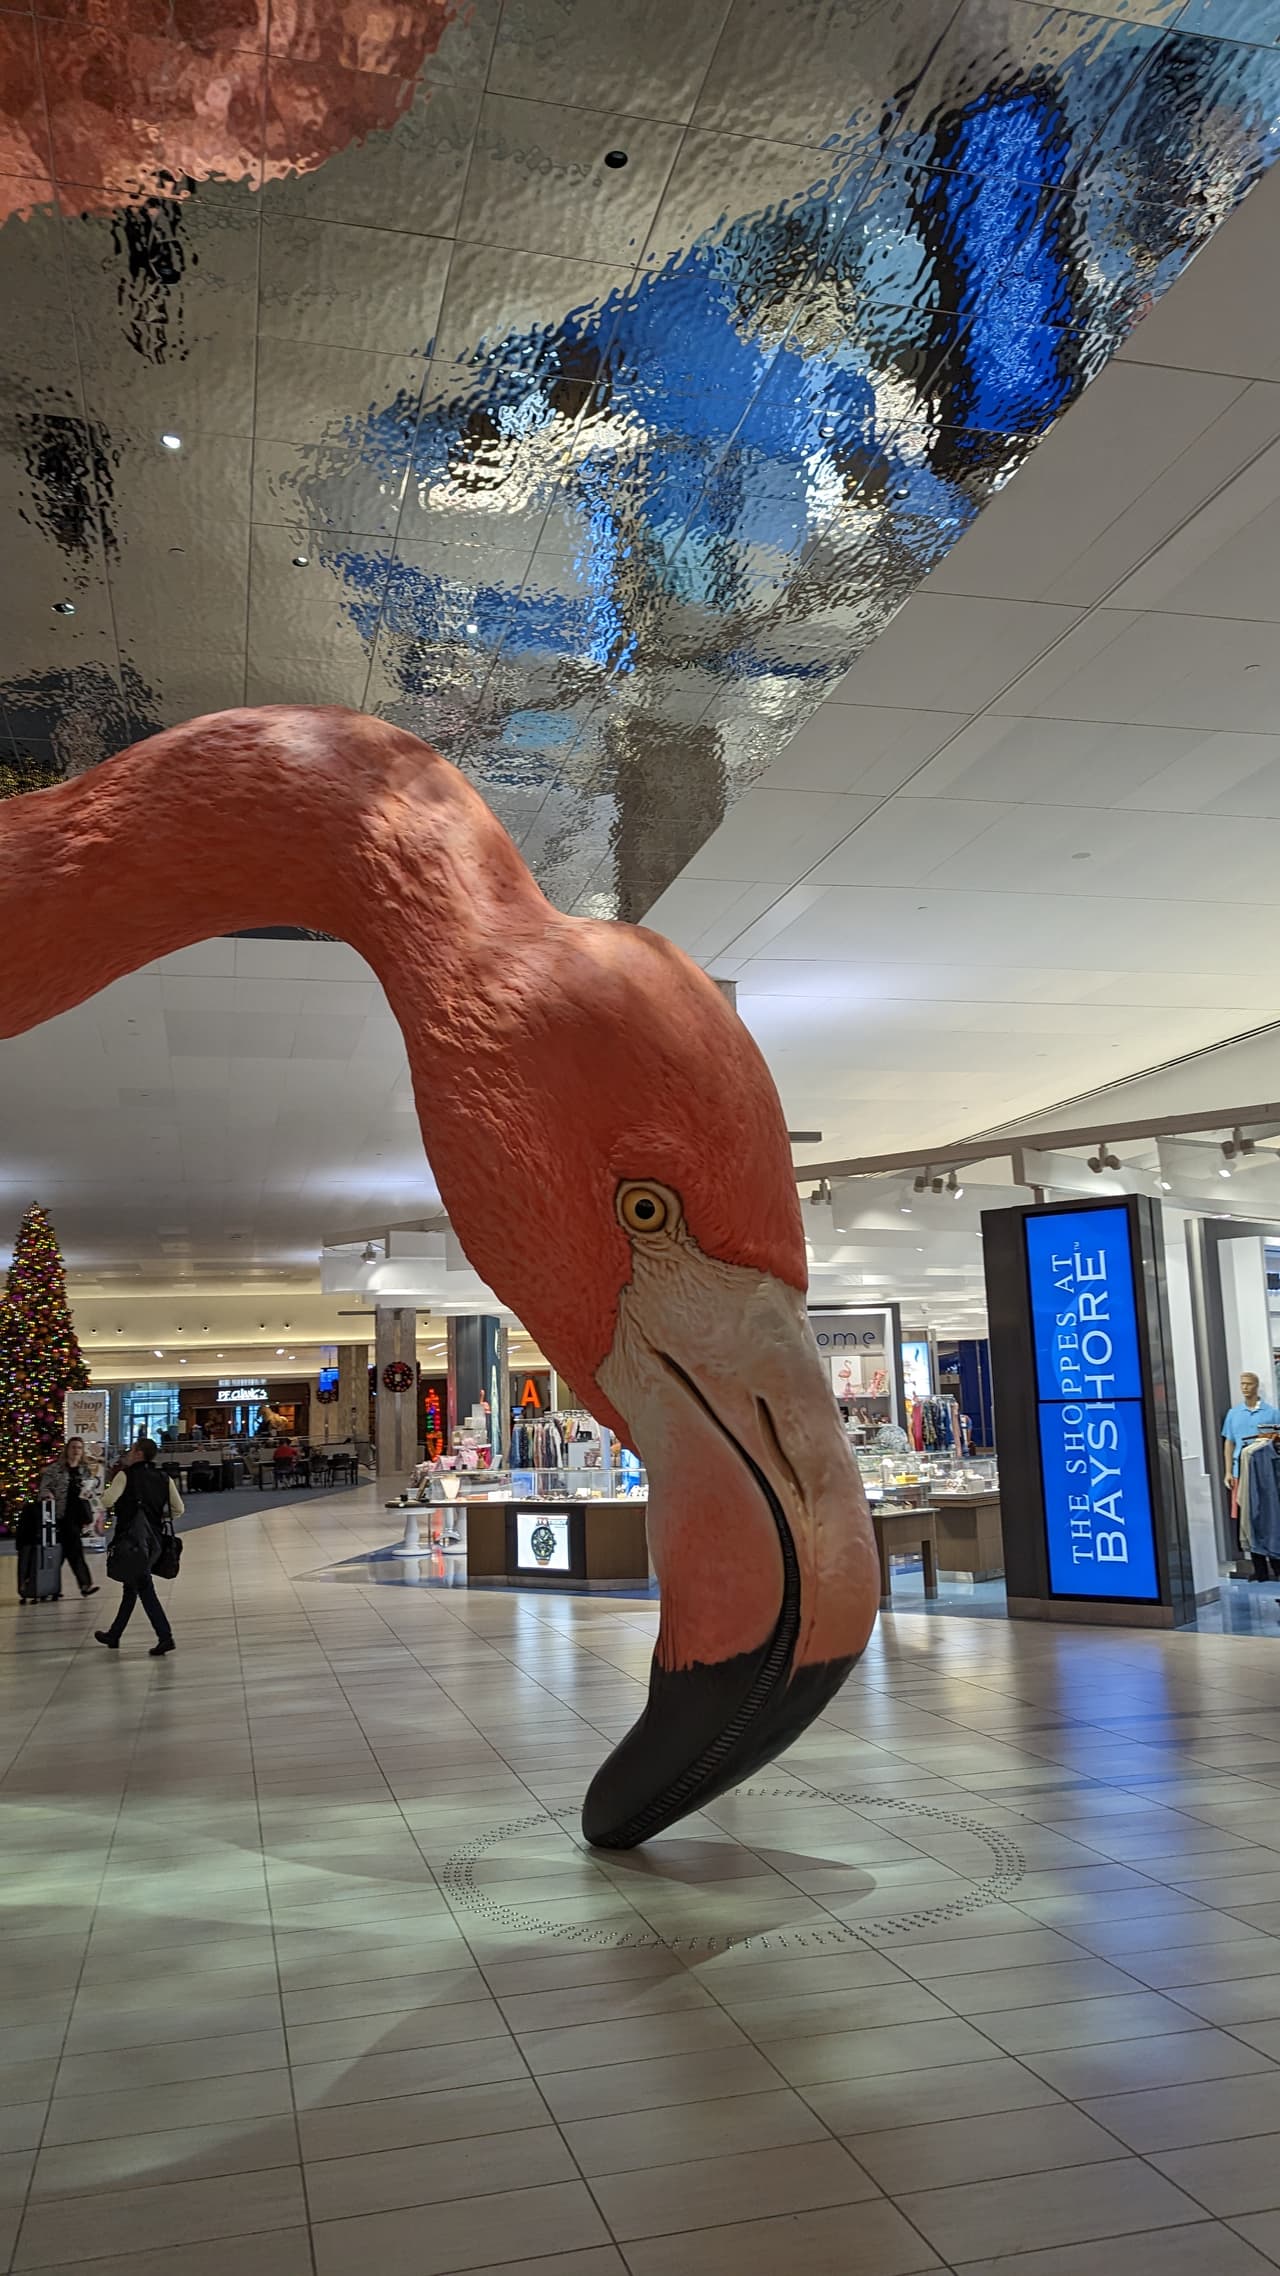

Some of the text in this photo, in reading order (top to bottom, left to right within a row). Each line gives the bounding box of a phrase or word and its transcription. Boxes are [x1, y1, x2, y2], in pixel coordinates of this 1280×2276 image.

[816, 1331, 876, 1346] ome
[520, 1378, 541, 1408] A
[1073, 1249, 1129, 1563] BAYSHORE
[1052, 1254, 1094, 1564] THE SHOPPES AT
[74, 1423, 98, 1434] TPA
